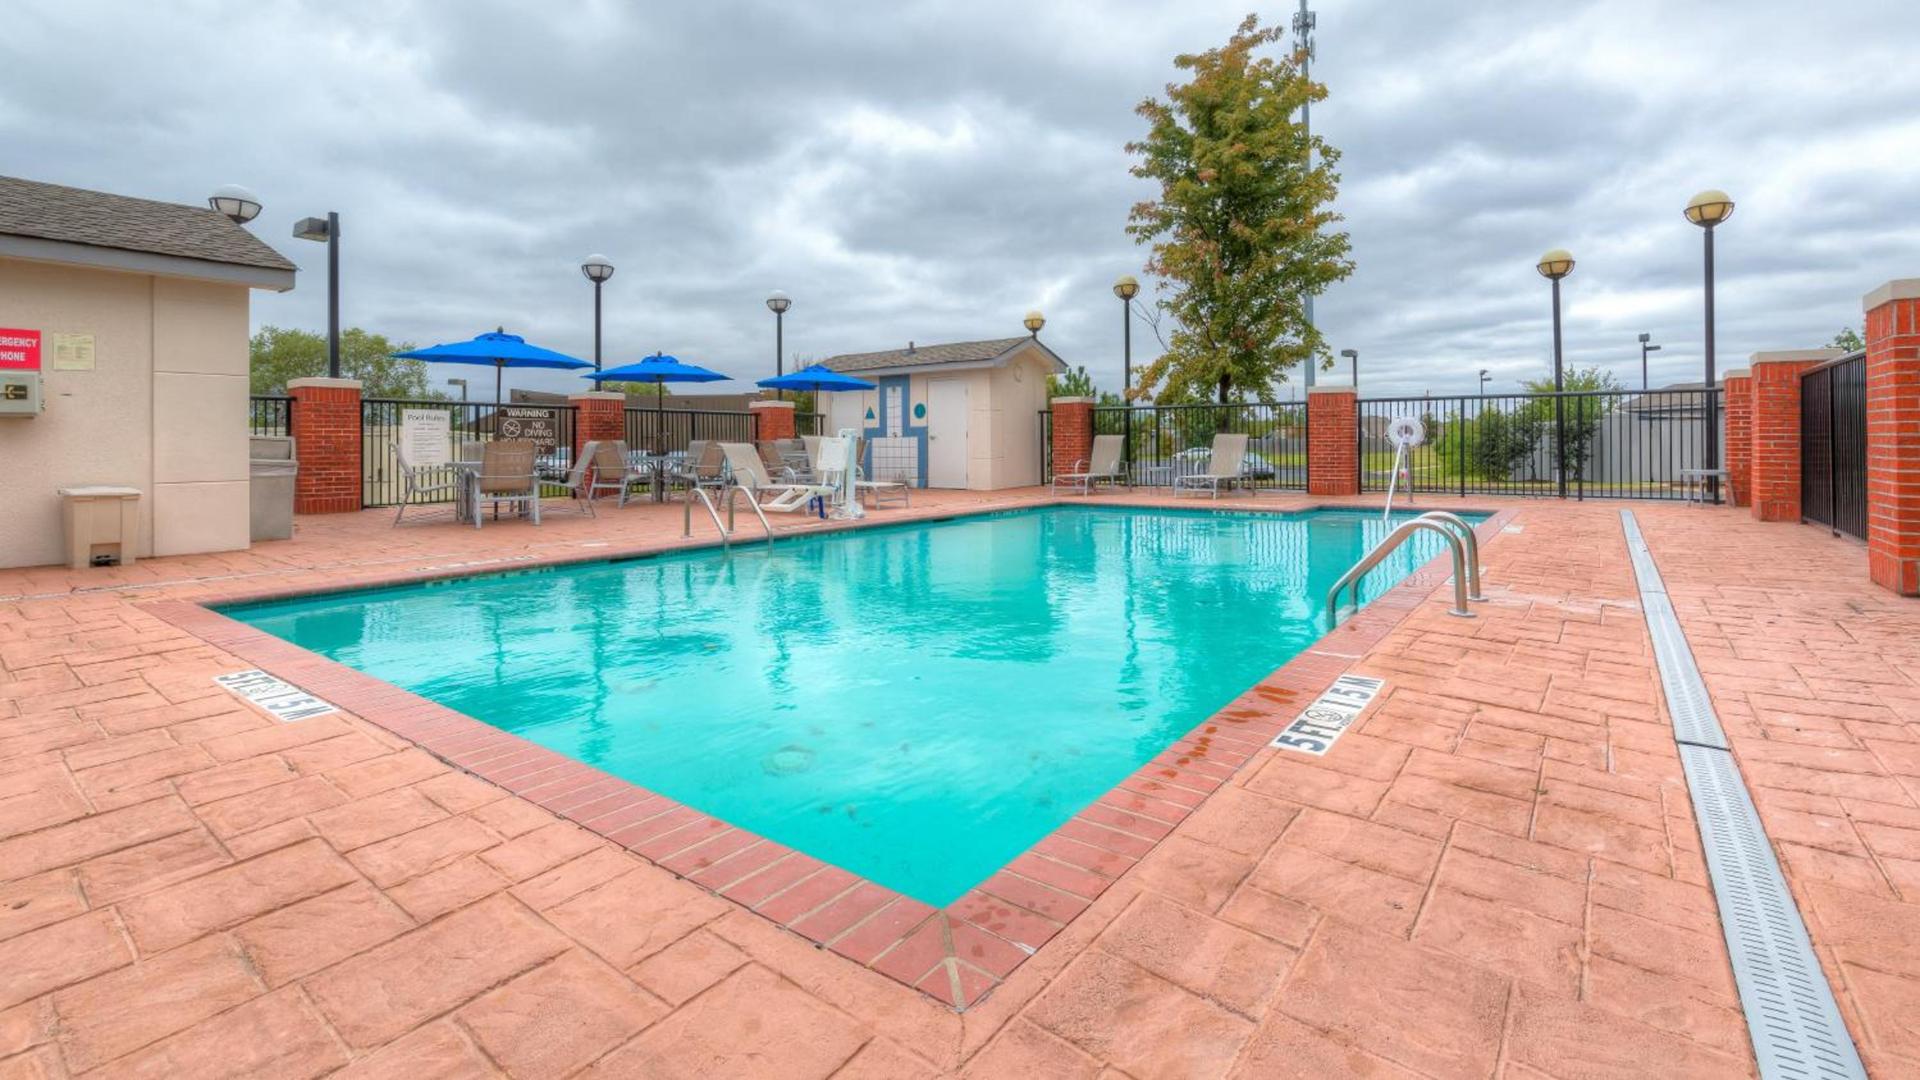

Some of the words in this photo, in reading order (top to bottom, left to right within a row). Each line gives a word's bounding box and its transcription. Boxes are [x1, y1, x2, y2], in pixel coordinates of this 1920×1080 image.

[0, 351, 25, 361] HONE
[507, 408, 550, 418] WARNING
[532, 421, 545, 429] NO
[524, 429, 553, 437] DIVING
[1276, 719, 1340, 752] 5FT
